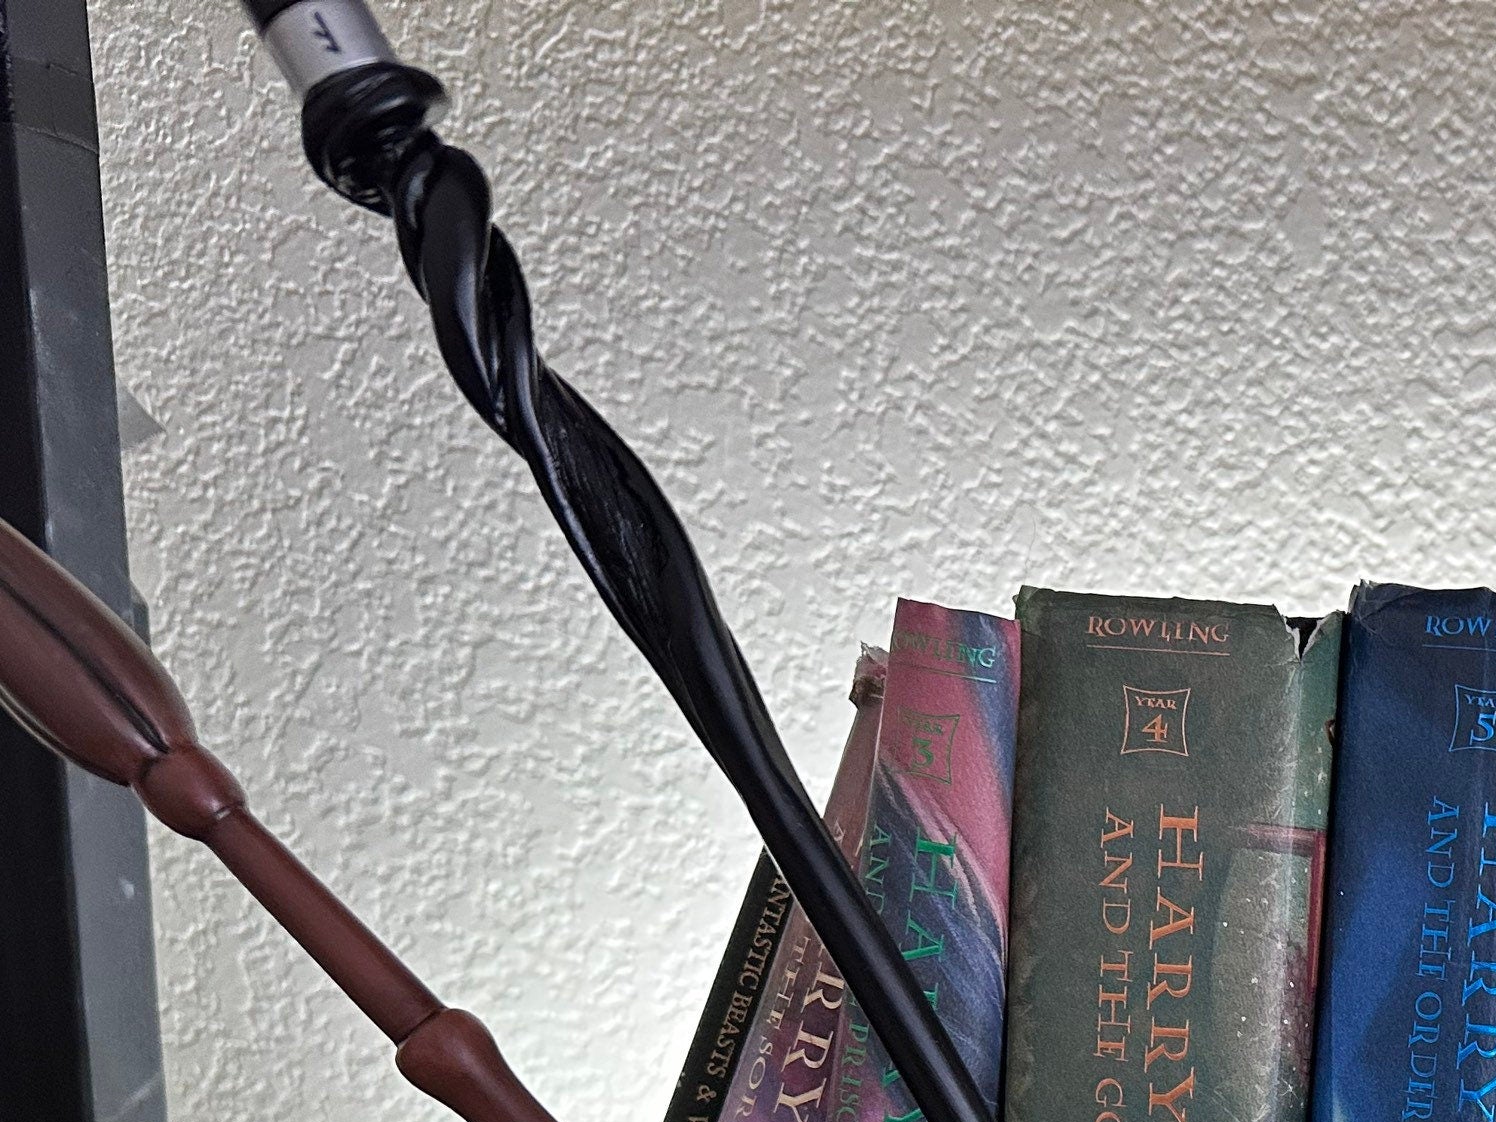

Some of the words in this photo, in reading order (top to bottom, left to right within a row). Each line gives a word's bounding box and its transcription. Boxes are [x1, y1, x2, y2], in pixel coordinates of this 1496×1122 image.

[1088, 615, 1231, 645] ROWLING
[1134, 694, 1178, 711] YEAR
[1141, 713, 1169, 743] 4
[910, 736, 935, 769] 3
[1098, 806, 1135, 936] AND
[1427, 796, 1461, 889] AND
[1416, 899, 1452, 982] THE
[706, 989, 755, 1079] BEASTS
[1093, 950, 1135, 1064] THE
[697, 1083, 718, 1107] &
[1401, 990, 1443, 1122] ORDER
